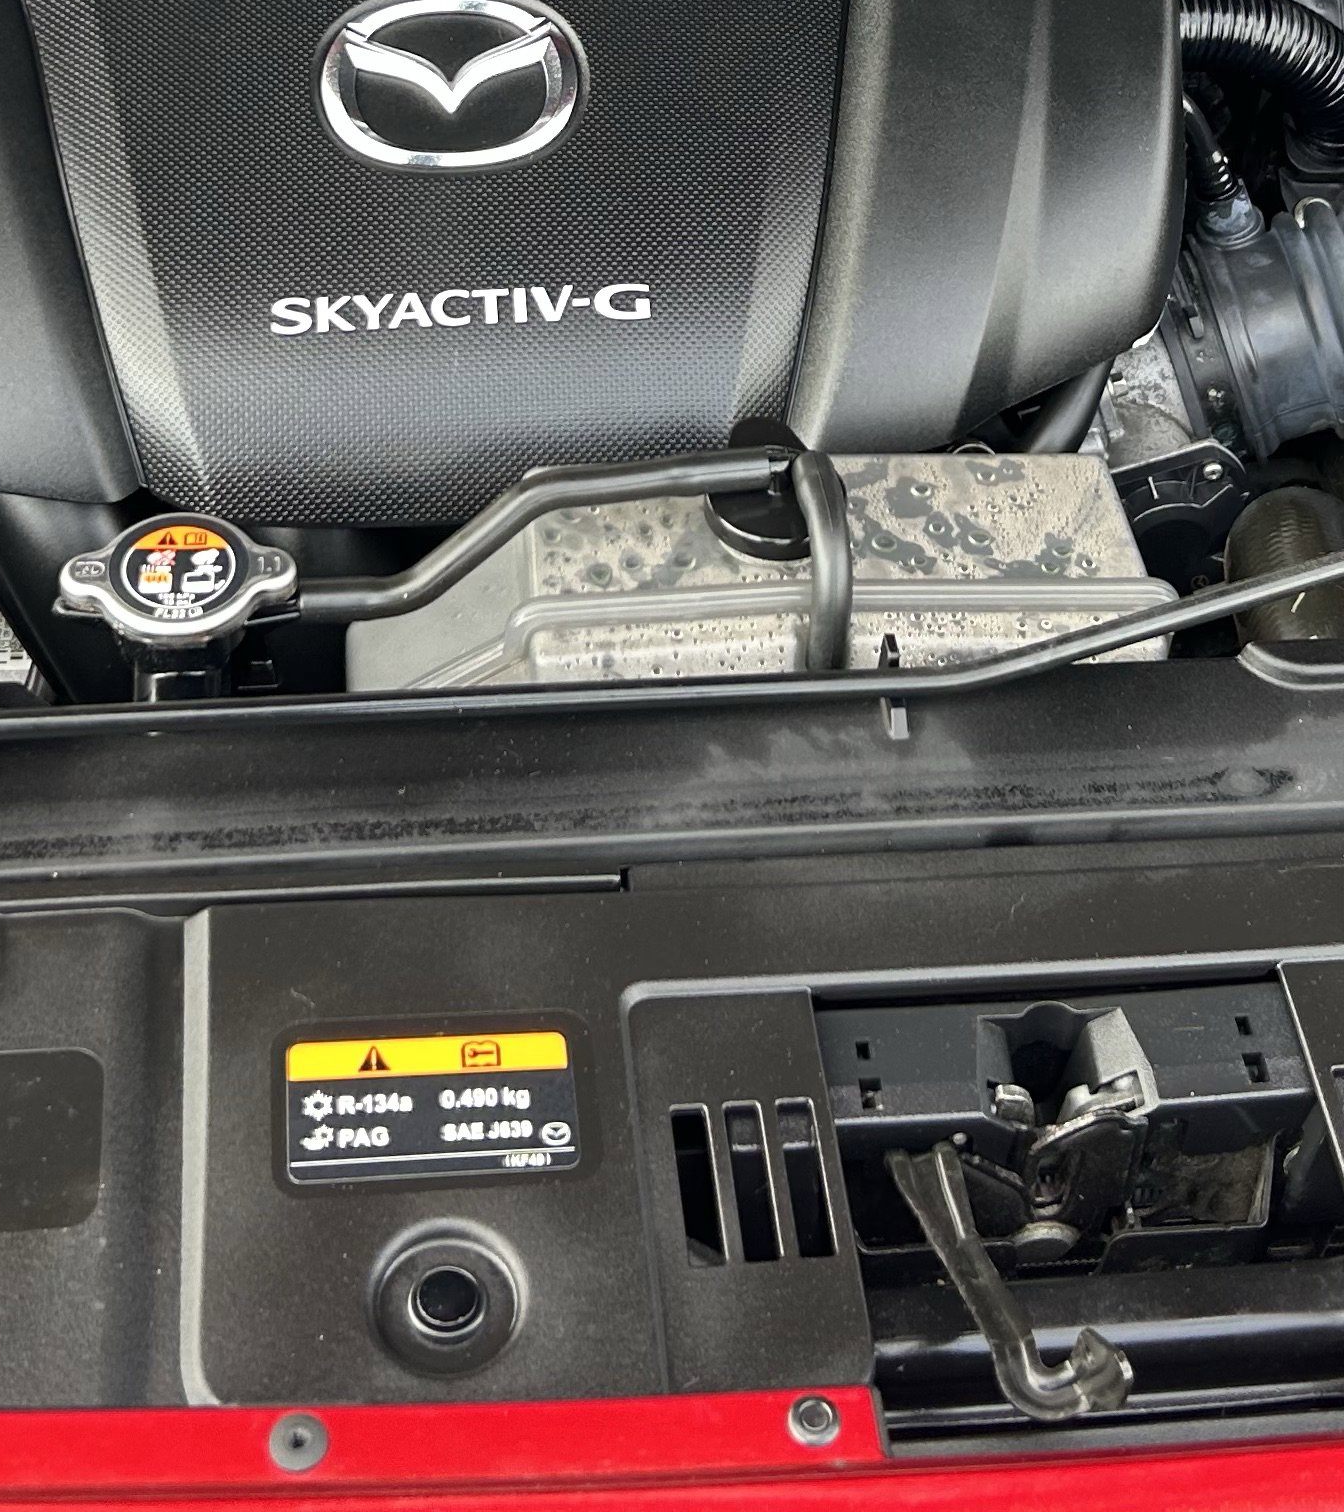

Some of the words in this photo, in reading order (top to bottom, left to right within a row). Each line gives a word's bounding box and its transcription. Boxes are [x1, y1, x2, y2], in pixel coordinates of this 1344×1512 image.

[270, 283, 652, 336] SKYACTIV-G
[256, 555, 281, 574] 1.1
[337, 1092, 413, 1115] R-134a
[440, 1087, 498, 1109] 0.490
[503, 1086, 530, 1110] kg
[338, 1126, 390, 1149] PAG
[442, 1121, 485, 1142] SAE
[487, 1120, 533, 1139] J639
